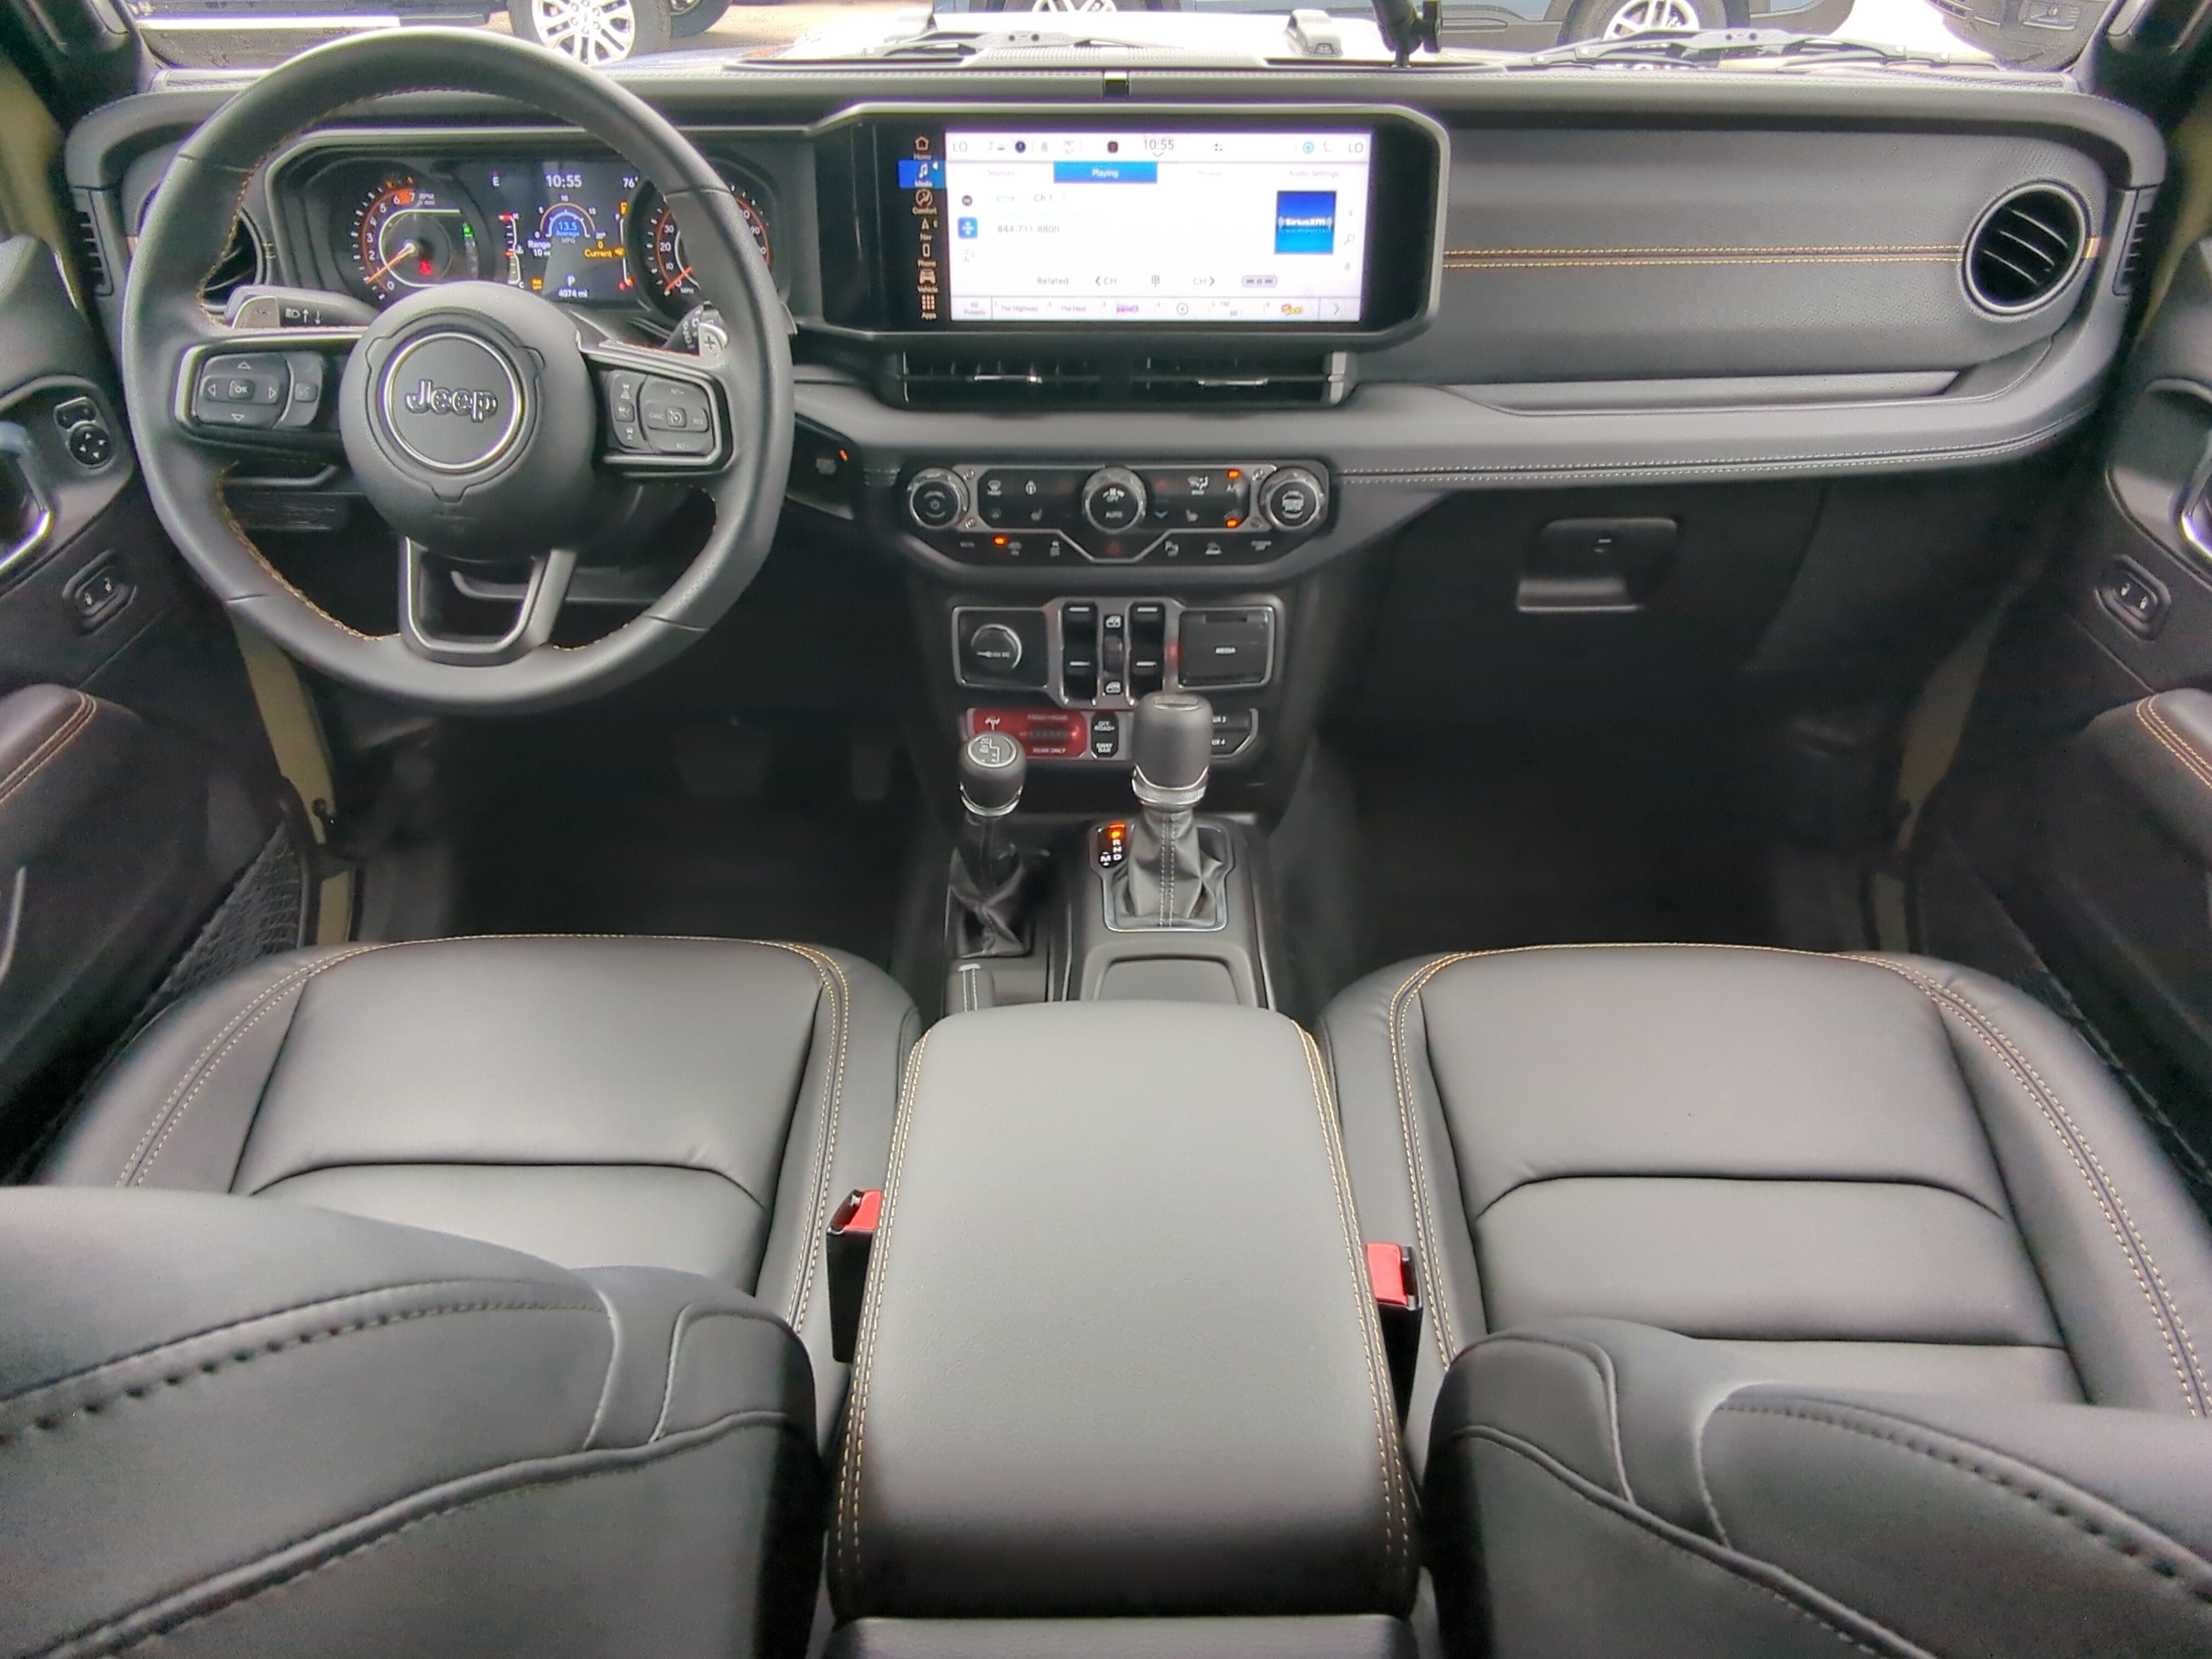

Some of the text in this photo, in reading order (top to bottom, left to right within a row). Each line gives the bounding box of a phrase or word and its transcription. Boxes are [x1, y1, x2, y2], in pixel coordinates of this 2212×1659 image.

[953, 142, 968, 153] LO
[1144, 139, 1175, 150] 10:55
[1348, 142, 1364, 153] LO
[1092, 168, 1119, 178] Playing
[492, 177, 500, 187] E
[545, 174, 582, 188] 10:55
[393, 195, 400, 205] 6
[1034, 194, 1046, 202] Ch
[380, 204, 386, 213] 5
[558, 221, 577, 231] 13.5
[664, 225, 674, 233] 30
[366, 233, 373, 242] 3
[527, 240, 551, 250] Range
[660, 242, 672, 252] 20
[369, 251, 375, 260] 2
[584, 249, 612, 258] Current
[665, 262, 674, 270] 10
[387, 281, 394, 290] 0
[567, 276, 575, 286] P
[1037, 277, 1069, 285] Related
[1104, 277, 1117, 285] CH
[1193, 277, 1206, 285] CH
[558, 290, 588, 298] 4074 mi
[234, 385, 248, 393] OK
[405, 379, 498, 423] Jeep
